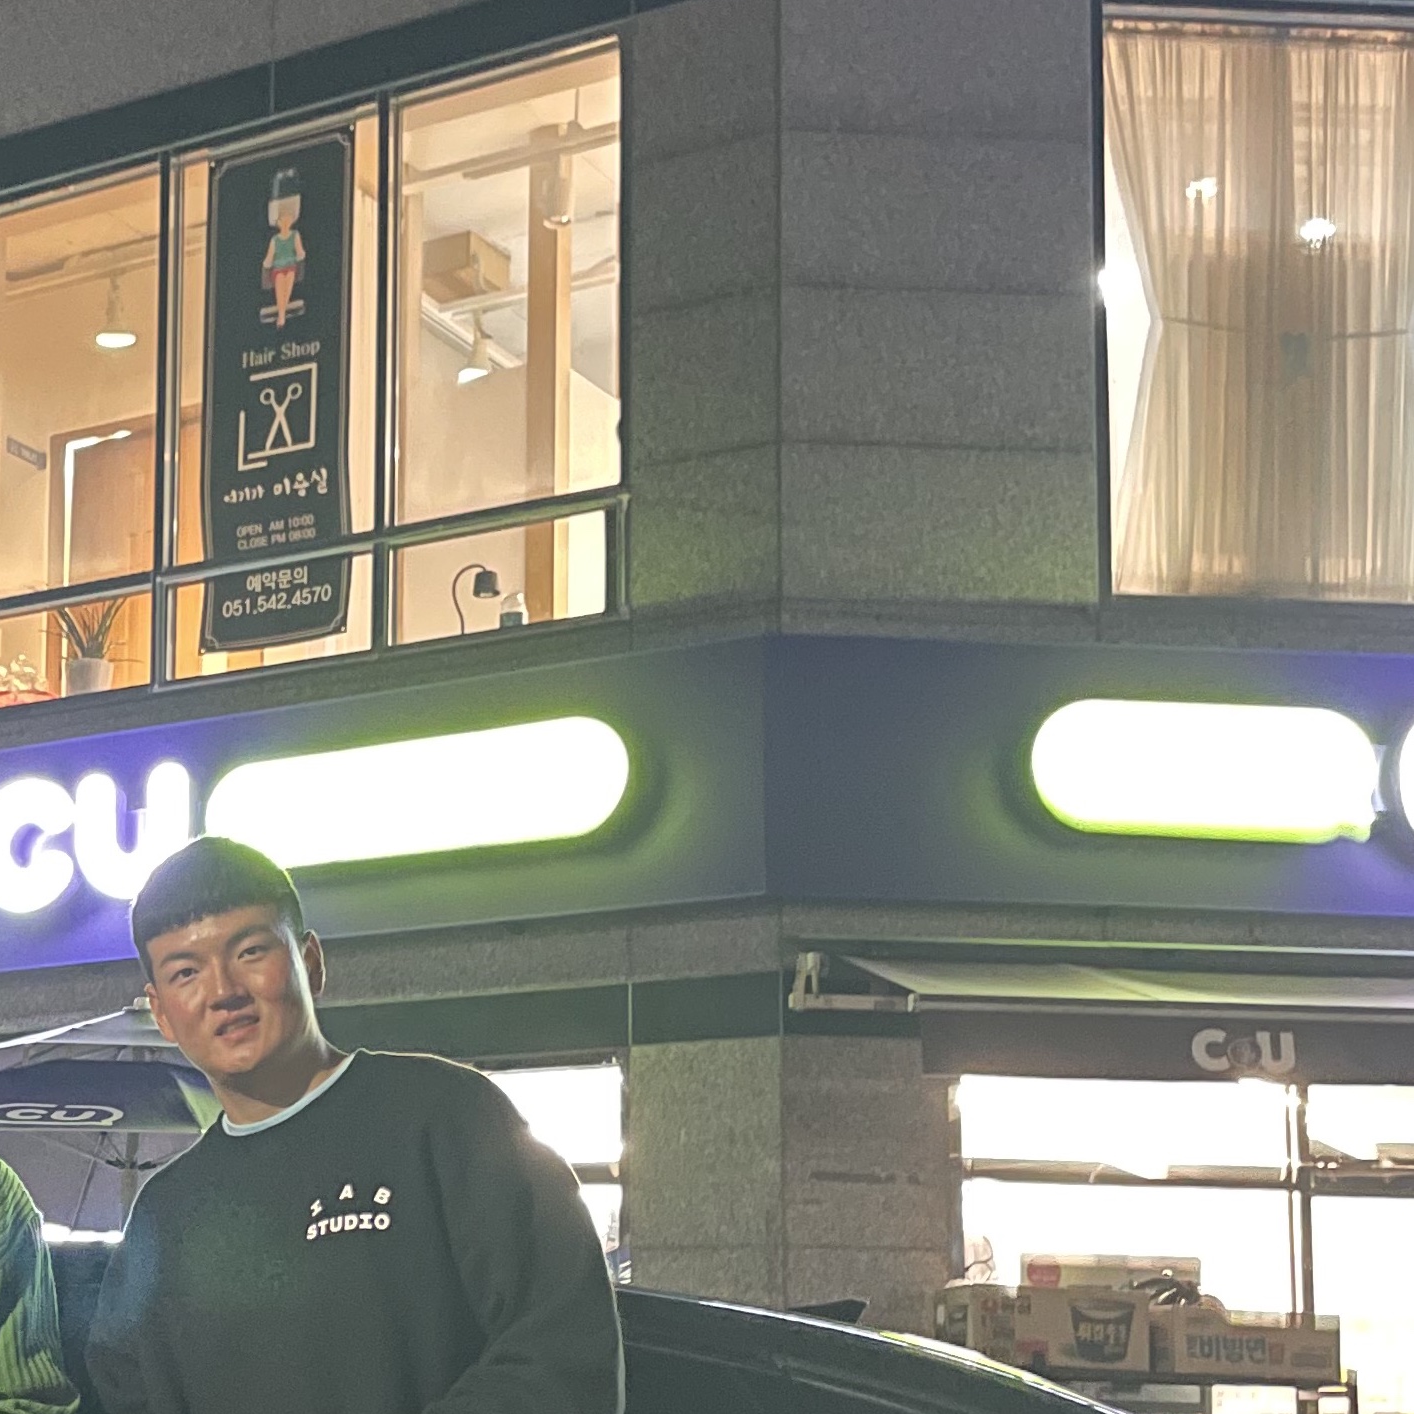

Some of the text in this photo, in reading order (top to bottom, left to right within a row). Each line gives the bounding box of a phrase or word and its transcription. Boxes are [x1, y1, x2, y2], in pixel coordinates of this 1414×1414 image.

[241, 341, 321, 369] Hair Shop
[272, 467, 328, 497] 미용실
[236, 523, 263, 538] OPEN
[268, 519, 285, 532] AM
[237, 535, 268, 551] CLOSE
[271, 532, 286, 545] PM
[246, 565, 308, 592] 예약문의
[222, 583, 332, 618] 051.542.4570
[6, 1108, 97, 1122] CU
[306, 1212, 391, 1240] STUDIO
